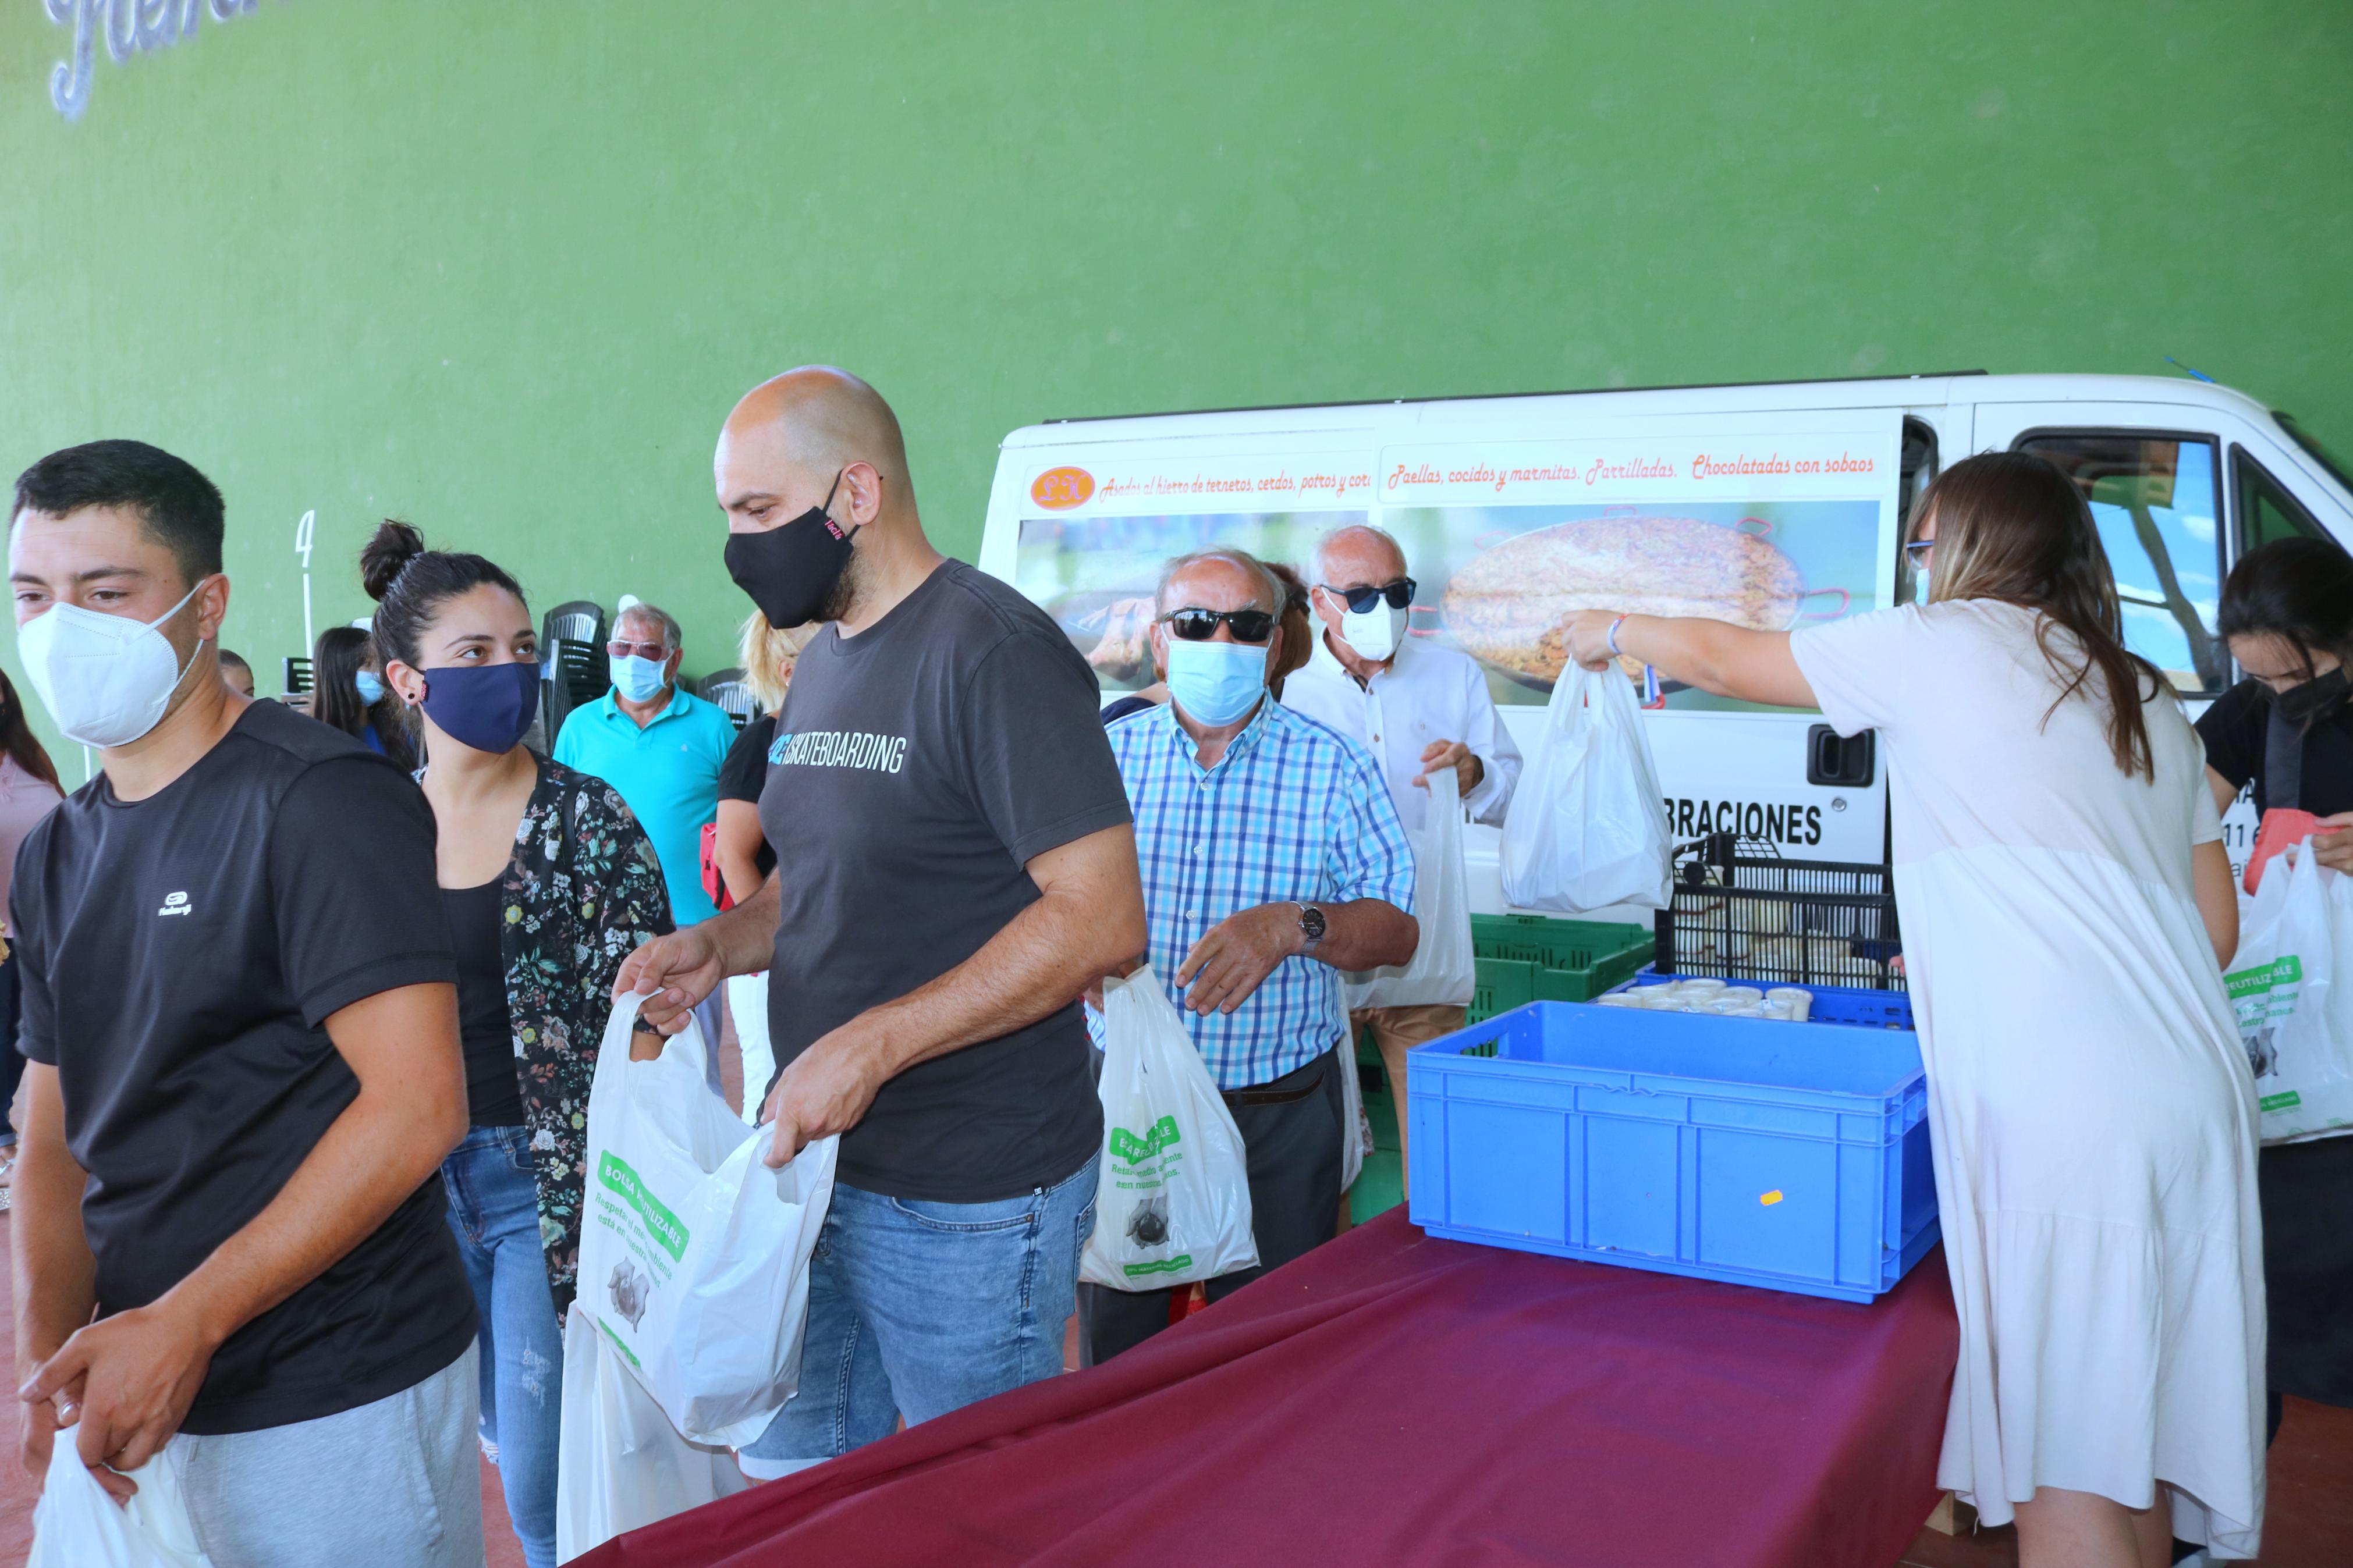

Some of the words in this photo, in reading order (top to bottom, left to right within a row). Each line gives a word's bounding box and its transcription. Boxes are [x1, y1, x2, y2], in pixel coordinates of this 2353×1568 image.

[1099, 477, 1140, 503] Asados
[1144, 475, 1155, 495] al
[1155, 475, 1189, 495] hierro
[1191, 473, 1204, 493] de
[1206, 478, 1254, 493] terneros,
[1258, 470, 1296, 490] cerdos,
[1298, 472, 1336, 499] potros
[1336, 474, 1347, 499] y
[1388, 463, 1443, 489] Paellas,
[1449, 462, 1495, 483] cocidos
[1495, 470, 1506, 492] y
[1510, 464, 1580, 481] marmitas.
[1585, 457, 1677, 486] Parrilladas.
[1692, 452, 1790, 479] Chocolatadas
[1795, 461, 1820, 474] con
[1824, 451, 1873, 472] sobaos
[605, 1165, 636, 1195] BOLSA
